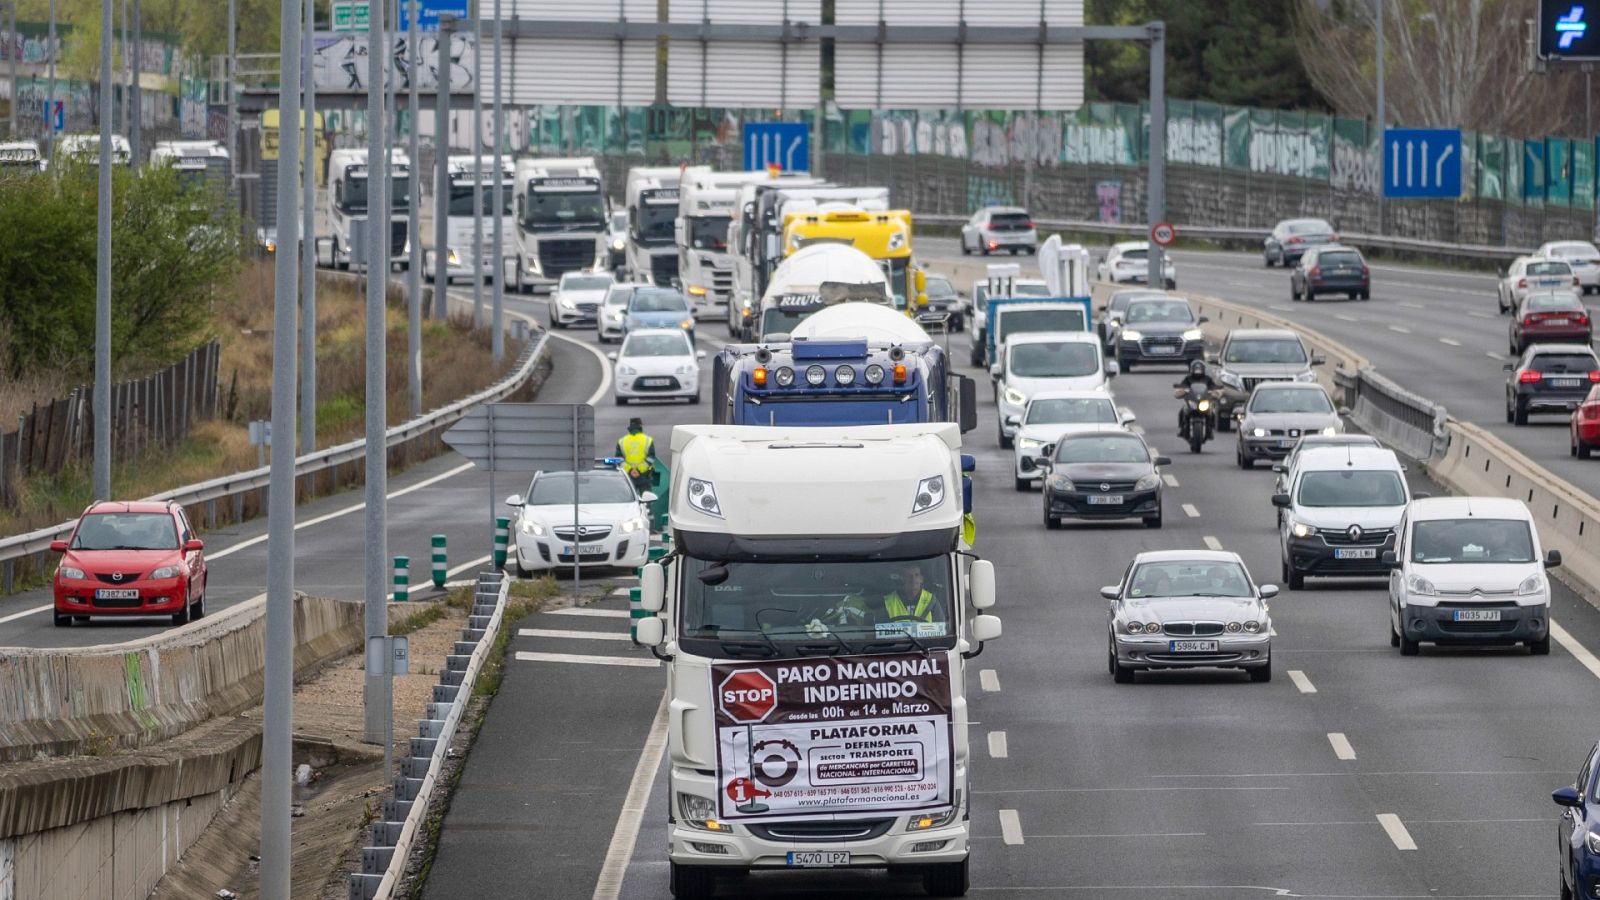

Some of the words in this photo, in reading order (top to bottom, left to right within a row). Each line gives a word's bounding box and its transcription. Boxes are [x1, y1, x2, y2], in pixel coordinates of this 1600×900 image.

[101, 590, 120, 598] 7387
[1460, 611, 1480, 620] 8035
[1177, 642, 1197, 651] 5984
[777, 664, 831, 684] PARO
[837, 658, 942, 680] NACIONAL
[724, 688, 773, 703] STOP
[804, 680, 918, 703] INDEFINIDO
[822, 705, 845, 718] 00h
[849, 709, 860, 717] del
[862, 703, 877, 716] 14
[892, 702, 930, 714] Marzo
[810, 723, 918, 741] PLATAFORMA
[844, 740, 891, 750] DEFENSA
[849, 748, 914, 759] TRANSPORTE
[828, 762, 869, 771] MERCANCIAS
[881, 760, 915, 768] CARRETERA
[820, 770, 856, 778] NACIONAL
[861, 767, 915, 777] INTERNACIONAL
[798, 792, 920, 807] www.plataformanacional.es
[795, 853, 822, 864] 5470
[827, 853, 847, 864] LPZ
